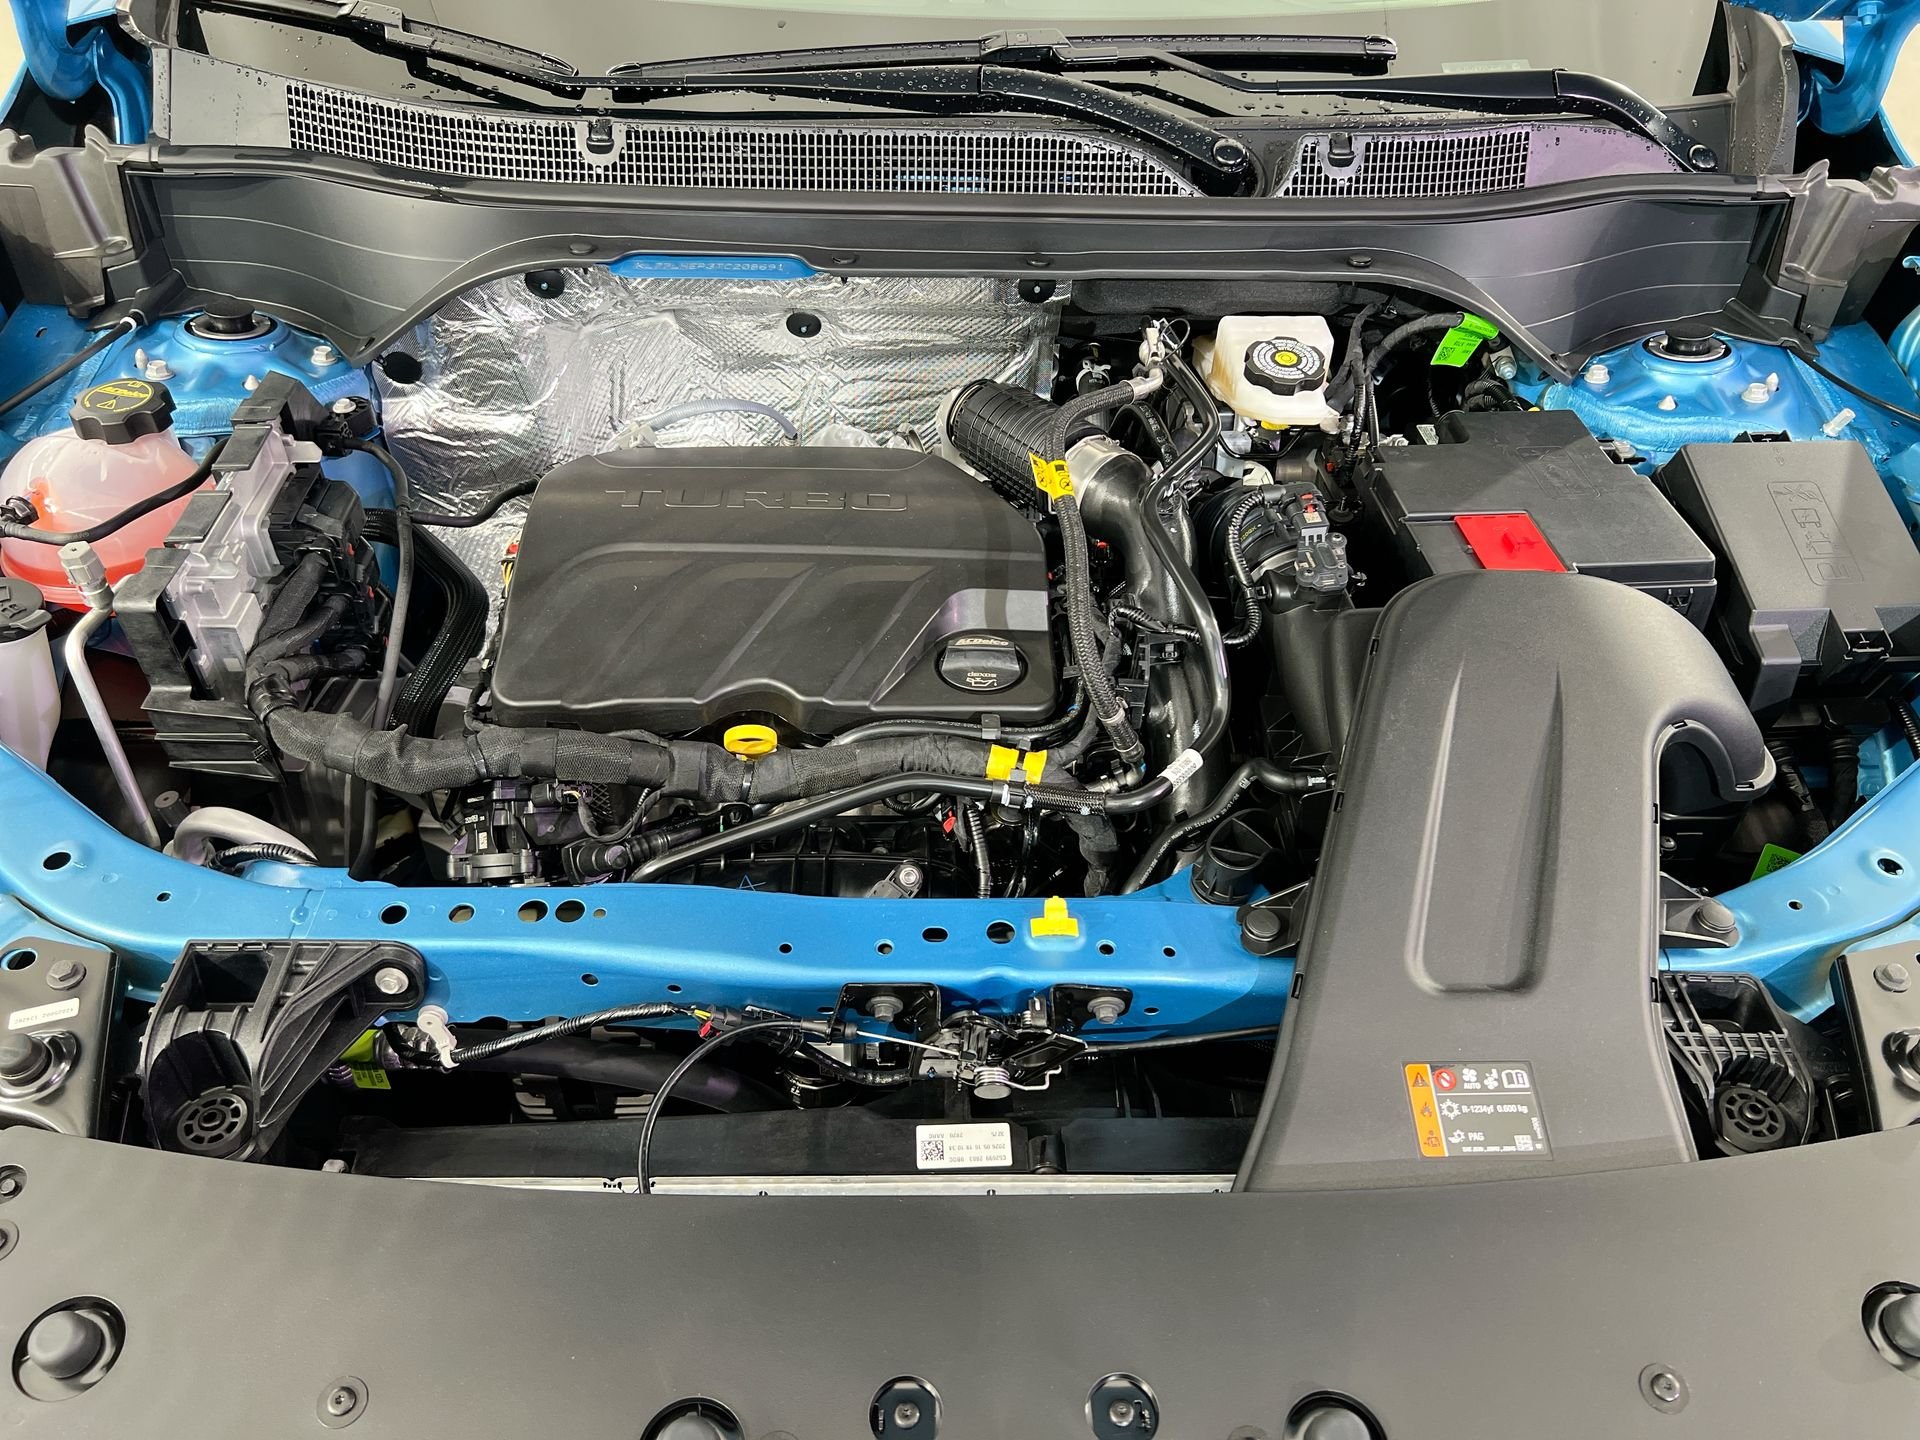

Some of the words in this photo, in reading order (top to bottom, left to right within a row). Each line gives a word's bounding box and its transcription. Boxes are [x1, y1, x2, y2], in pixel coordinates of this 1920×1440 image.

[605, 489, 908, 511] TURBO
[1461, 1104, 1494, 1115] R-1234yf
[1468, 1132, 1485, 1141] PAG
